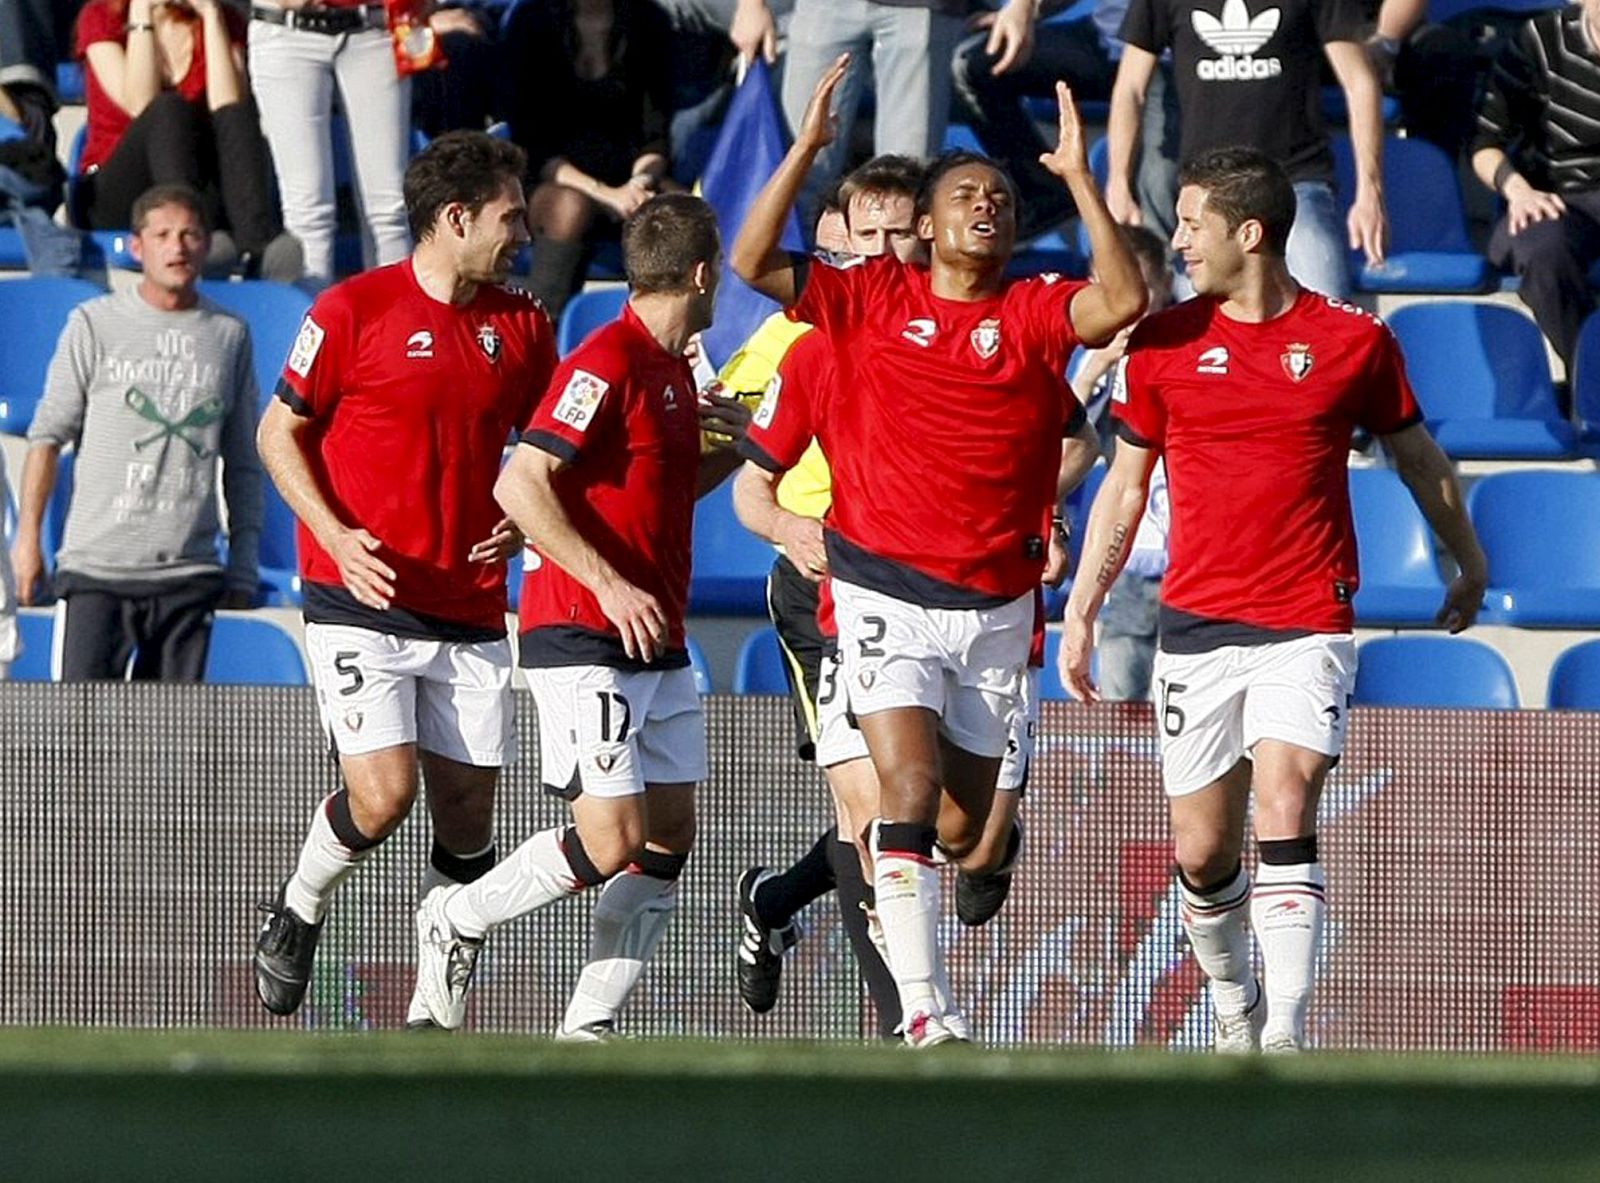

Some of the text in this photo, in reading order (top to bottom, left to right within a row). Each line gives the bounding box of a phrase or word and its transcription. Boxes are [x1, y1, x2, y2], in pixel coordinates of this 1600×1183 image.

[1196, 55, 1282, 81] adidas
[557, 402, 587, 424] LFP
[858, 615, 887, 658] 2
[334, 651, 365, 697] 5
[596, 691, 631, 742] 17
